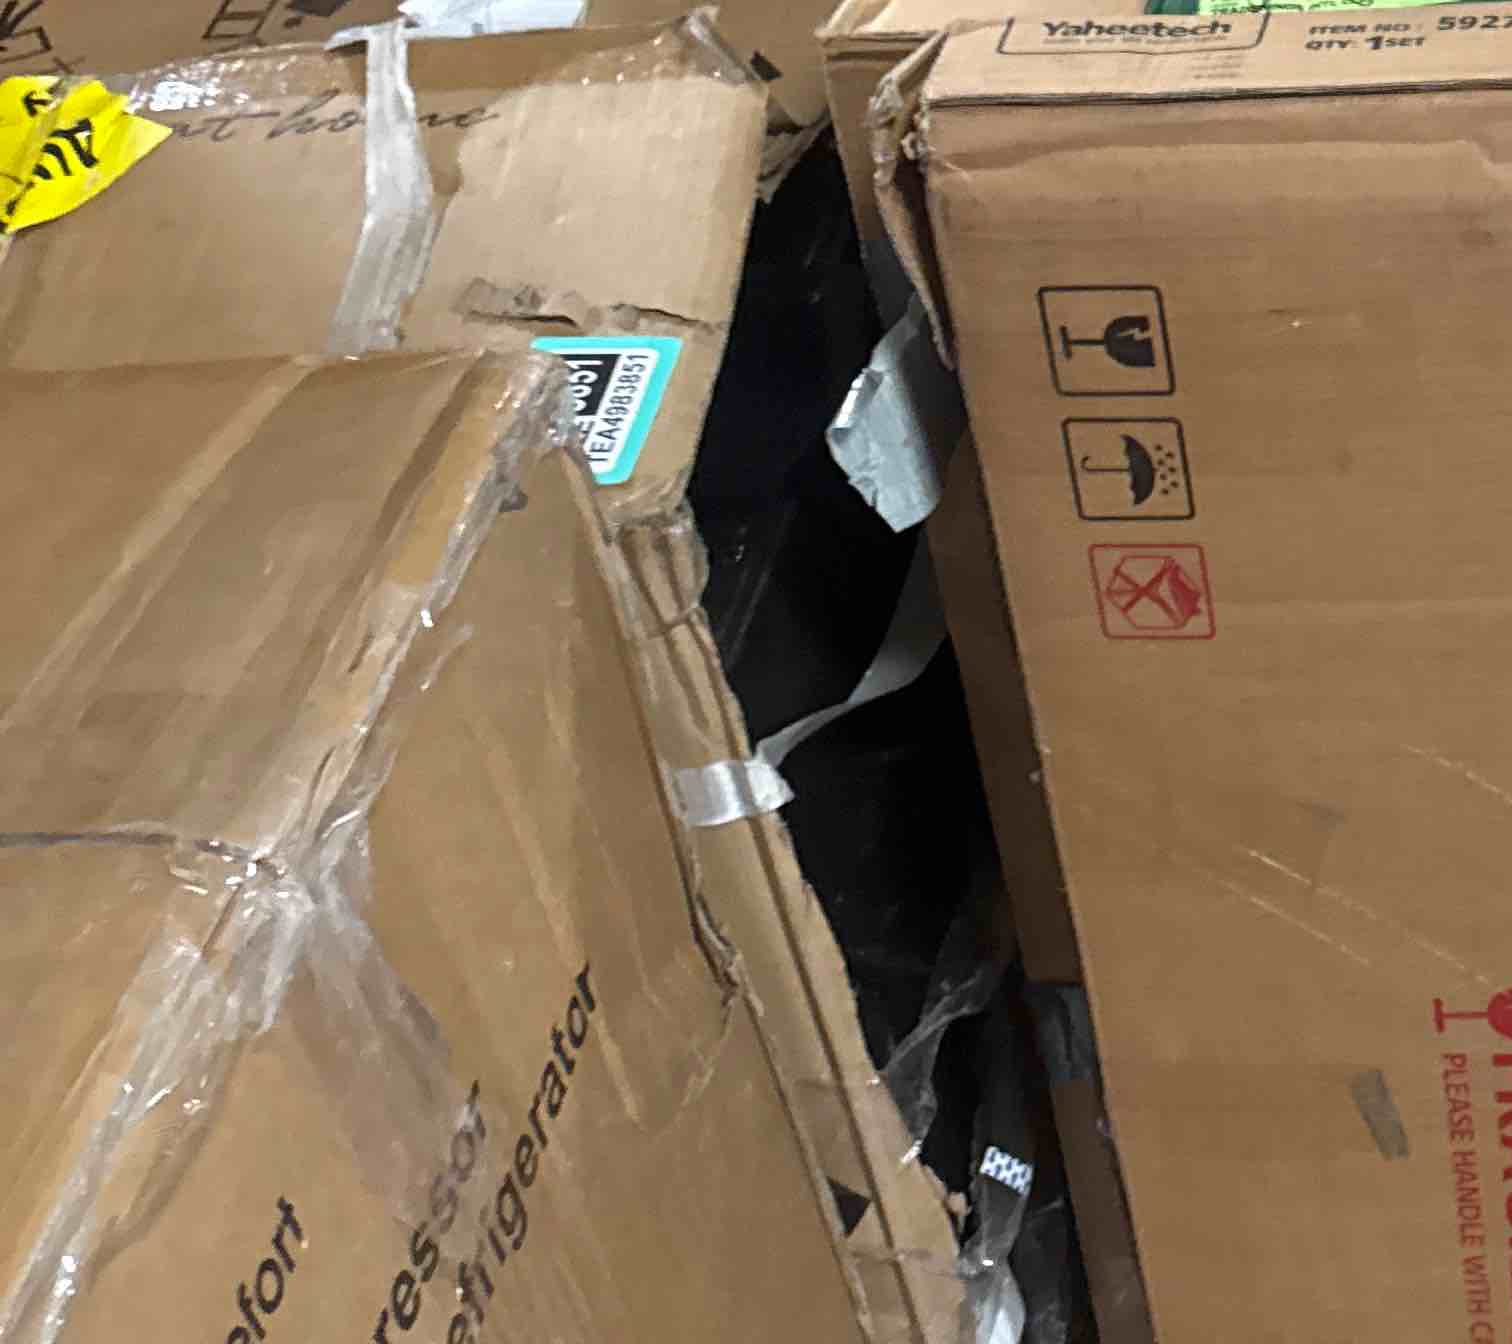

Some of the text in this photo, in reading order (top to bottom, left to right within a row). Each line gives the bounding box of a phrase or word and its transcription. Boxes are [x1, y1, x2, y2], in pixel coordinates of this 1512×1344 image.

[1043, 19, 1233, 38] Yaheetech
[1307, 23, 1368, 37] ITEM
[1440, 1051, 1475, 1145] PLEASE
[1451, 1150, 1484, 1252] HANDLE
[1461, 1257, 1492, 1315] WITH
